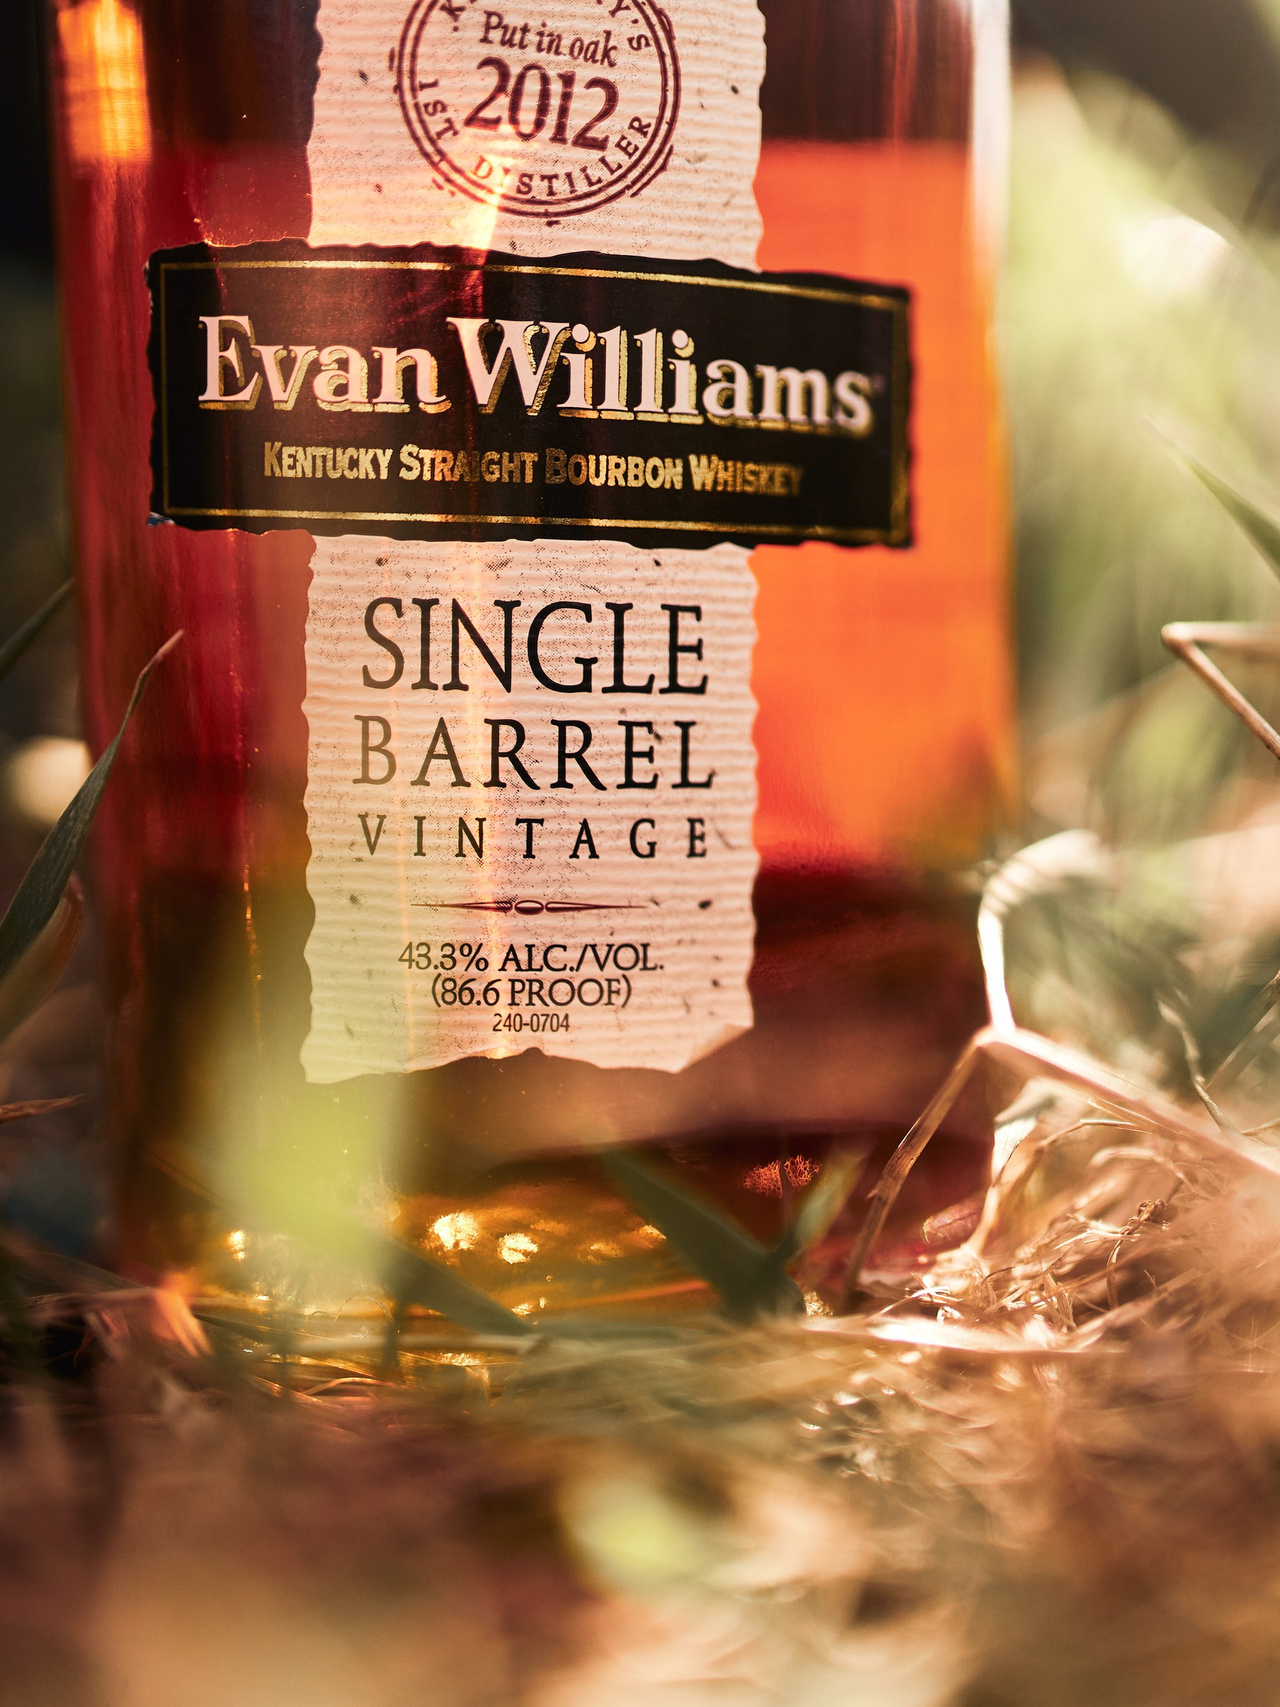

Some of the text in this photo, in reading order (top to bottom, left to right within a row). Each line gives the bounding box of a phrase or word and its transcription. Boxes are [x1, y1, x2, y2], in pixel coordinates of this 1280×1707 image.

[480, 10, 532, 50] Put
[535, 20, 565, 57] in
[568, 30, 618, 68] oak
[463, 56, 620, 151] 2012
[471, 115, 652, 196] DISTILLER
[198, 315, 874, 434] Evan Williams
[264, 441, 803, 497] KENTUCKY STRAIGHT BOURBON WHISKEY
[362, 597, 709, 694] SINGLE
[352, 714, 716, 791] BARREL
[358, 813, 708, 860] VINTAGE
[398, 941, 665, 972] 43.3% ALC./VOL.
[431, 973, 632, 1009] (86.6 PROOF)
[492, 1013, 571, 1033] 240-0704
